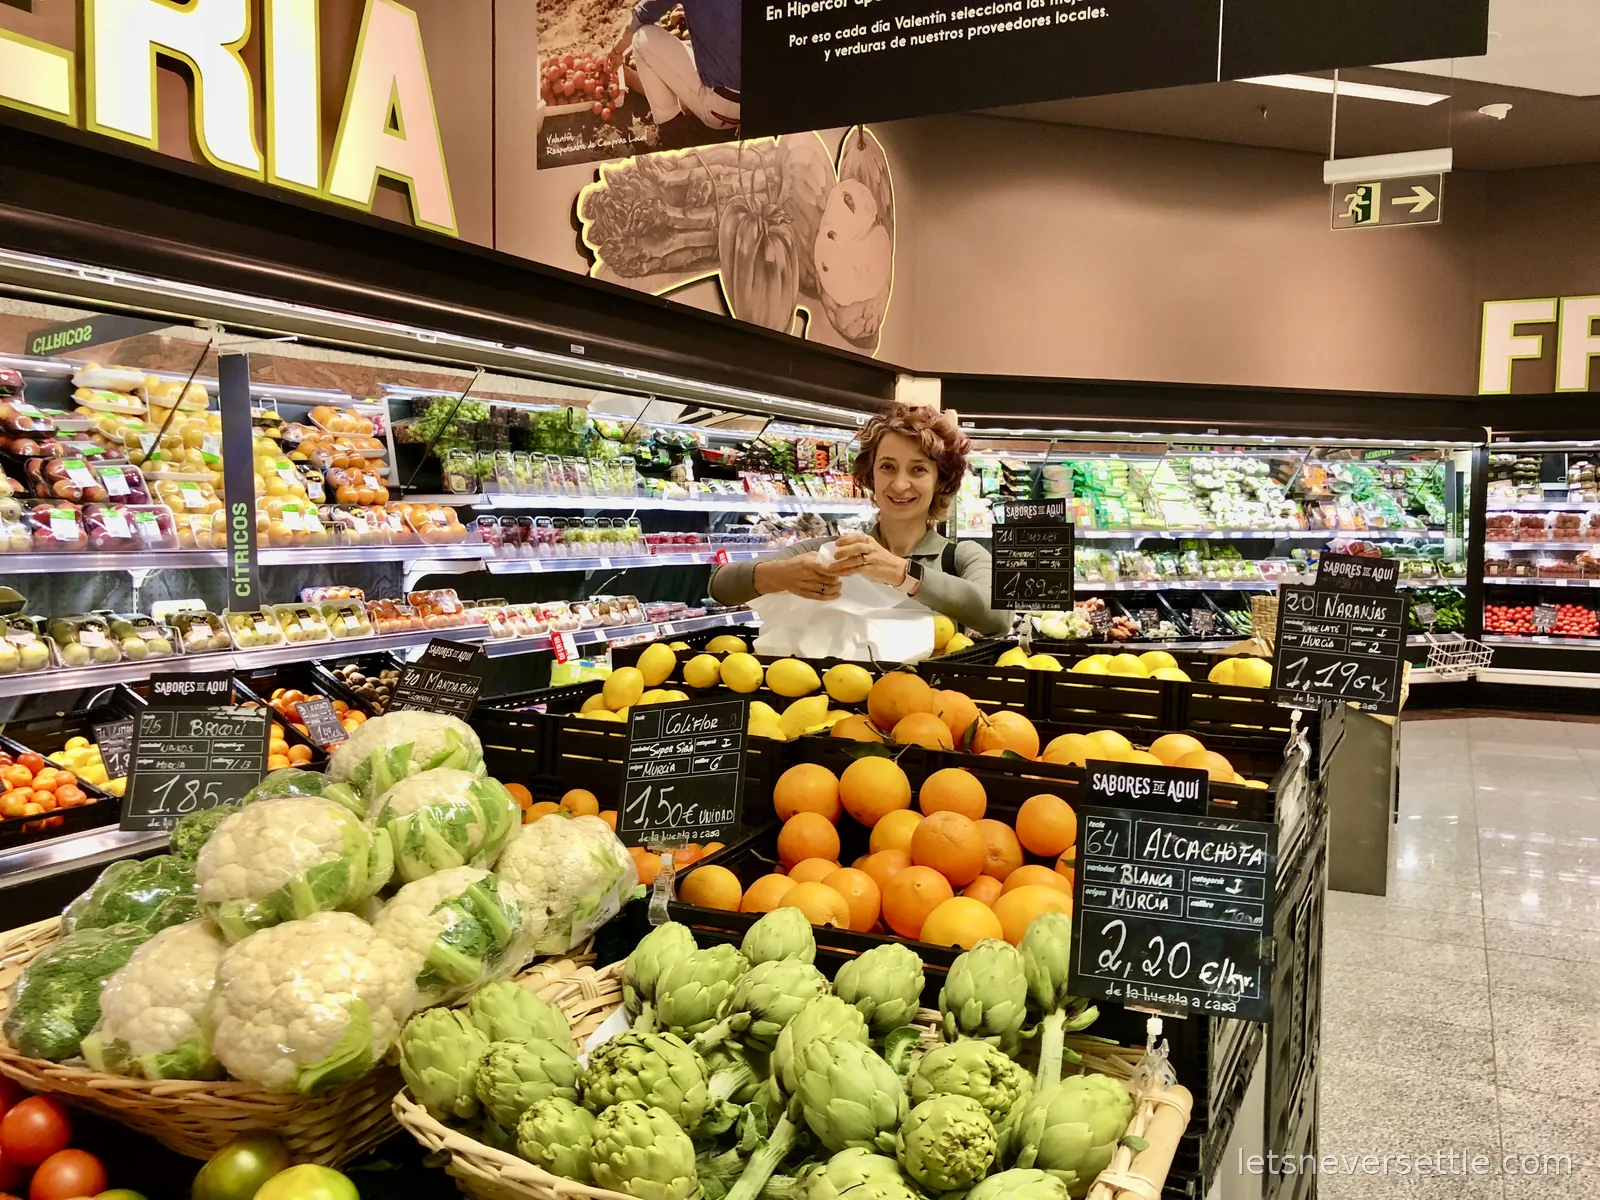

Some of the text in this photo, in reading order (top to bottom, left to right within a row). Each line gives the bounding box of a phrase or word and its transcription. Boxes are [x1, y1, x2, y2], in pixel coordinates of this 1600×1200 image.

[766, 6, 783, 21] En
[787, 0, 847, 18] Hipercor
[789, 34, 808, 47] Por
[812, 32, 831, 43] eso
[835, 24, 867, 39] cada
[871, 20, 890, 33] día
[895, 11, 947, 29] Valentín
[951, 4, 1022, 21] selecciona
[824, 7, 1109, 61] y verduras de nuestros proveedores locales.
[598, 137, 627, 149] Compras
[628, 128, 648, 144] Local
[1006, 504, 1038, 520] SABORES
[1046, 501, 1065, 518] AQUÍ
[232, 502, 251, 597] CÍTRICOS
[1323, 561, 1362, 579] SABORES
[1372, 567, 1394, 583] AQUÍ
[1286, 595, 1314, 611] 20
[428, 644, 454, 659] SABORES
[553, 635, 566, 661] OFERTA
[1368, 642, 1382, 654] 2
[154, 681, 196, 696] SABORES
[206, 679, 228, 695] AQUÍ
[1092, 773, 1151, 799] SABORES
[1167, 779, 1200, 803] AQUÍ
[638, 832, 648, 843] de
[650, 831, 660, 842] la
[692, 831, 698, 839] a
[699, 829, 720, 839] casa
[1087, 829, 1119, 857] 64
[1096, 919, 1191, 979] 2,20
[1105, 982, 1122, 996] de
[1125, 983, 1139, 998] la
[1191, 997, 1200, 1008] a
[1204, 999, 1237, 1013] casa
